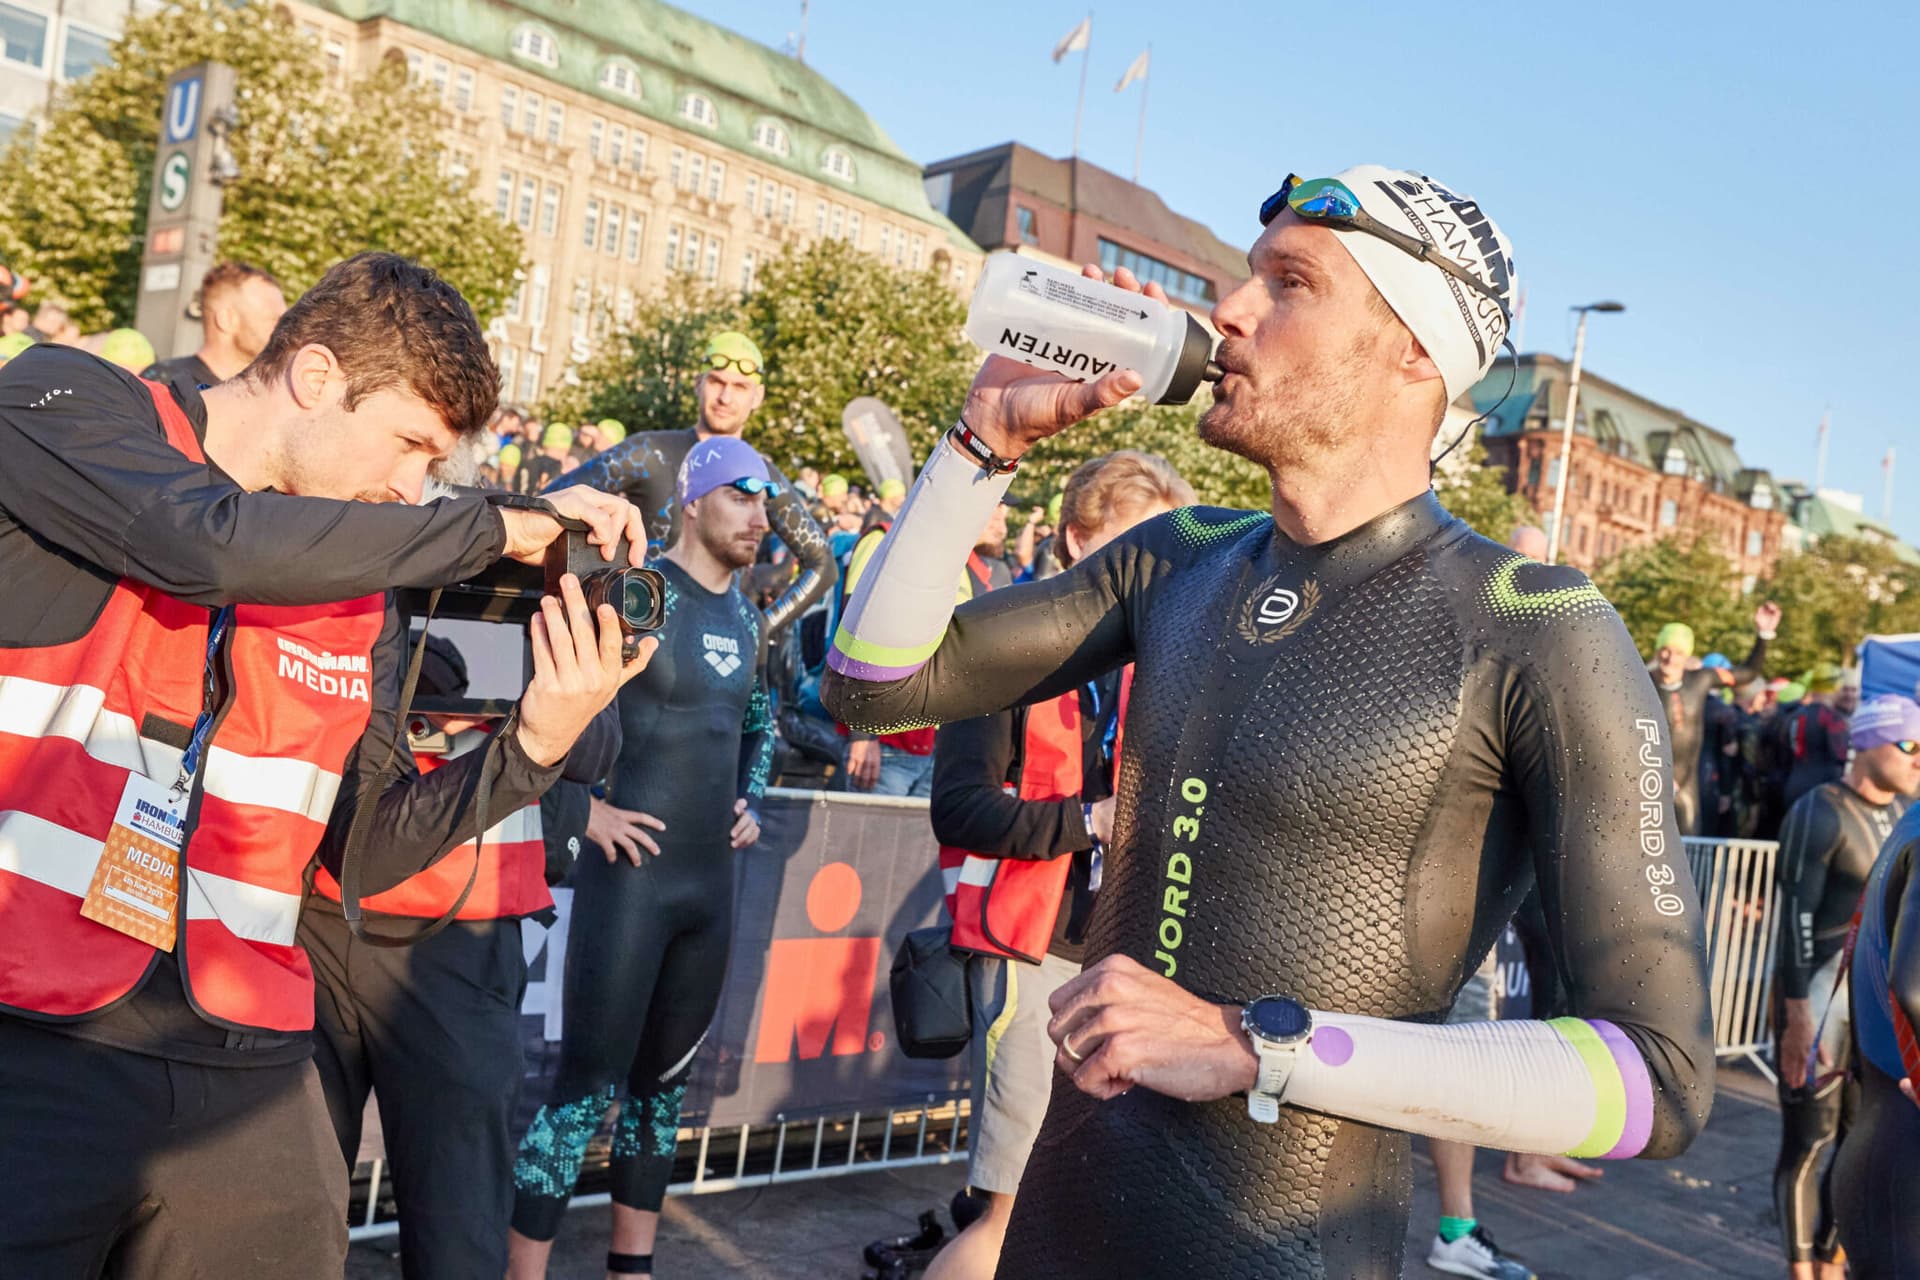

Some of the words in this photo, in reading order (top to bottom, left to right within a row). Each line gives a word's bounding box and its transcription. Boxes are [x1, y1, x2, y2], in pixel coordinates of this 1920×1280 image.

[170, 79, 200, 141] U
[161, 152, 189, 210] S
[1441, 268, 1482, 343] HAMPIONSHIP
[1000, 327, 1118, 376] AURTEN
[703, 633, 740, 656] arena
[278, 654, 369, 703] MEDIA
[136, 798, 186, 831] IRONMA
[1173, 777, 1208, 843] 3.0
[1635, 718, 1666, 858] FJORD
[141, 814, 184, 842] HAMBUR
[127, 846, 175, 880] MEDIA
[1646, 863, 1686, 917] 3.0
[1155, 852, 1193, 978] JORD
